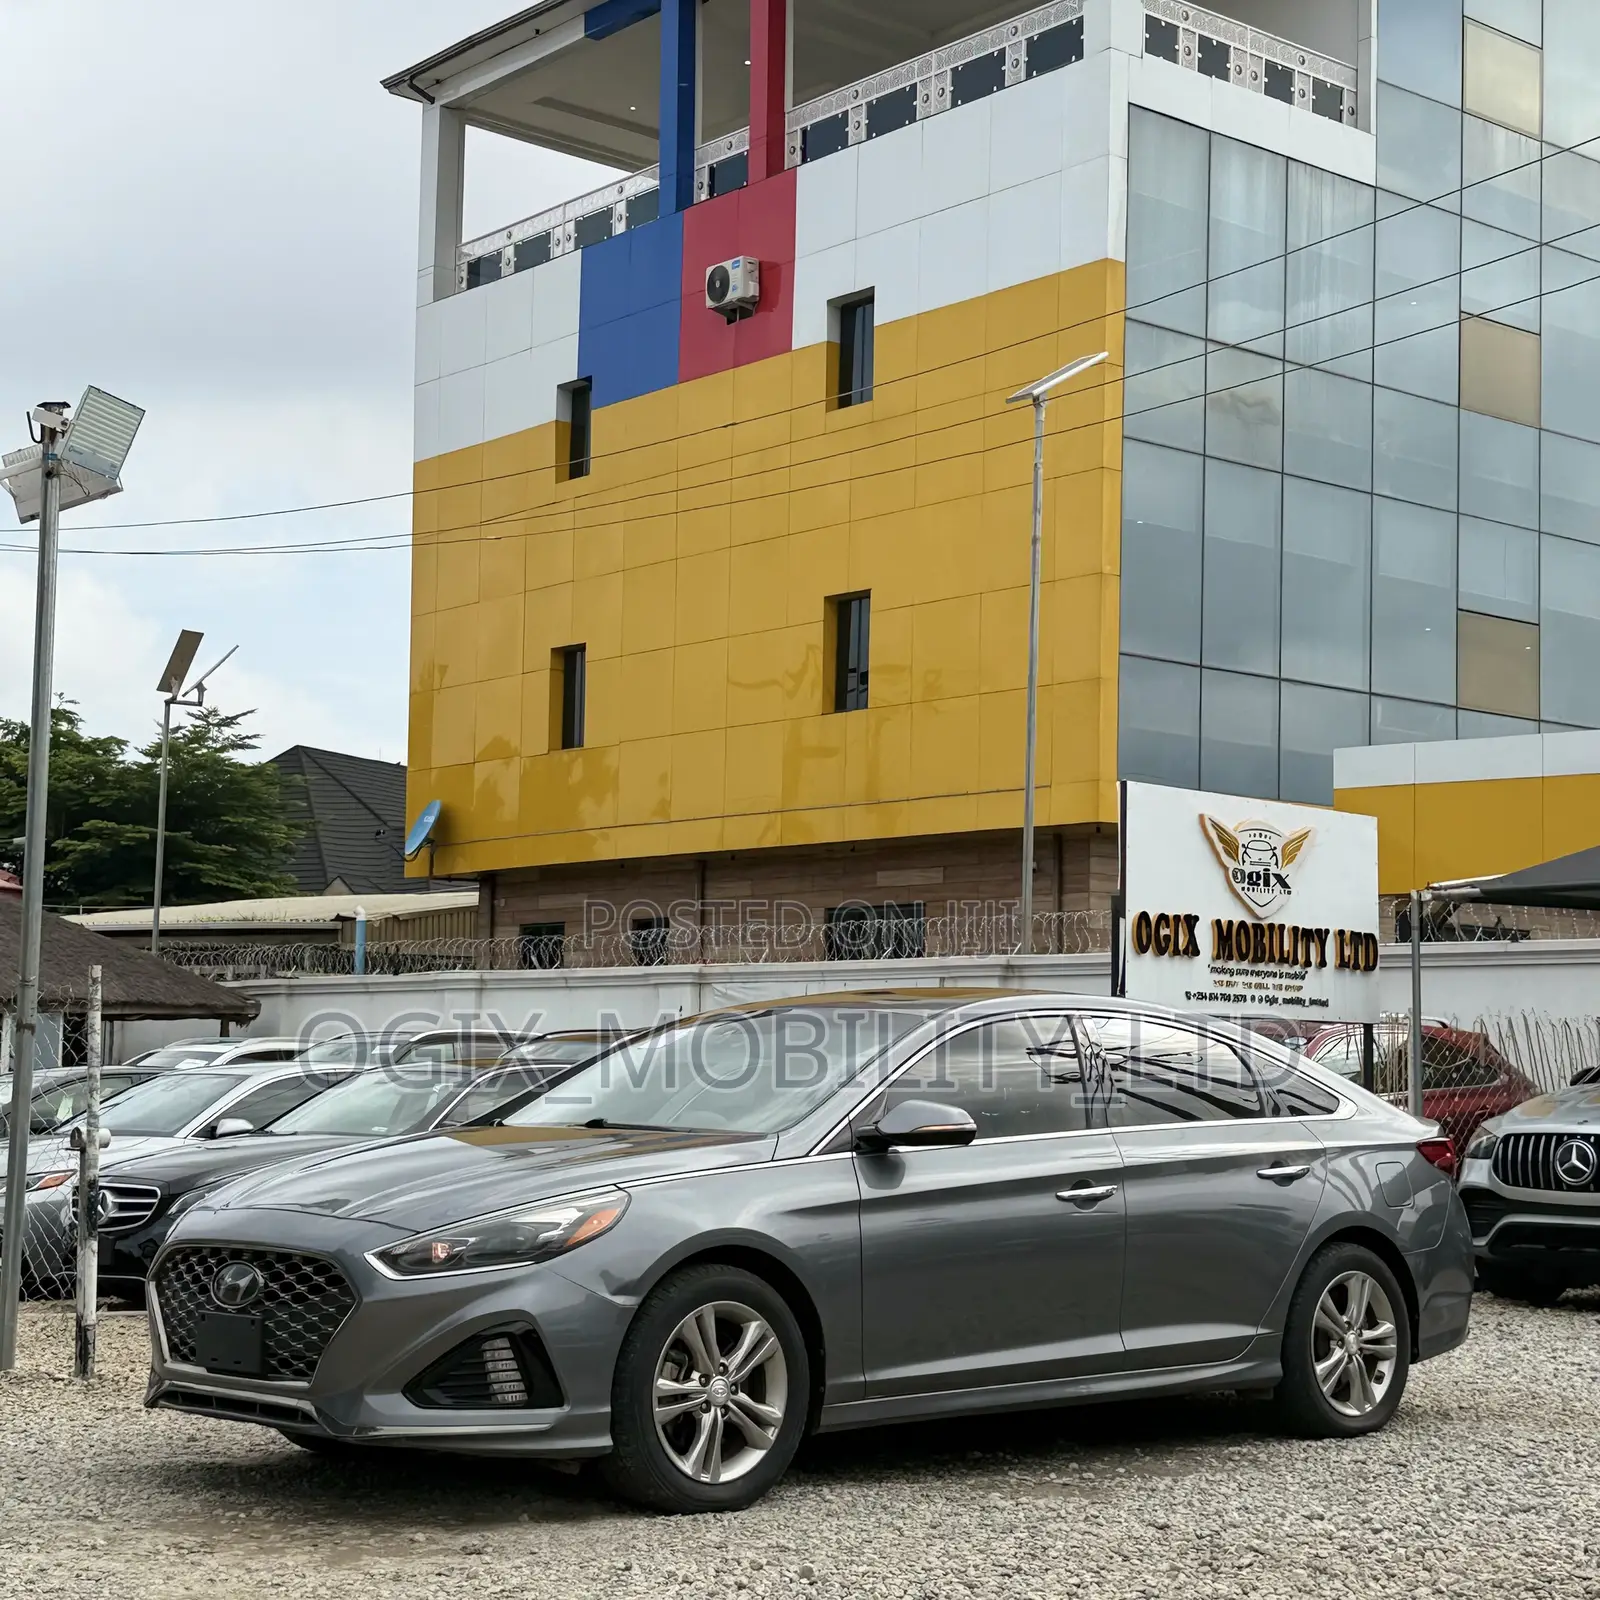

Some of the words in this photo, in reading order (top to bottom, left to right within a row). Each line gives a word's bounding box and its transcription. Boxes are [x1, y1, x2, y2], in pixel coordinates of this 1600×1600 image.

[1232, 867, 1292, 889] Ogix
[1132, 910, 1201, 959] OGIX
[1211, 918, 1331, 969] MOBILITY
[1334, 928, 1380, 973] LTD
